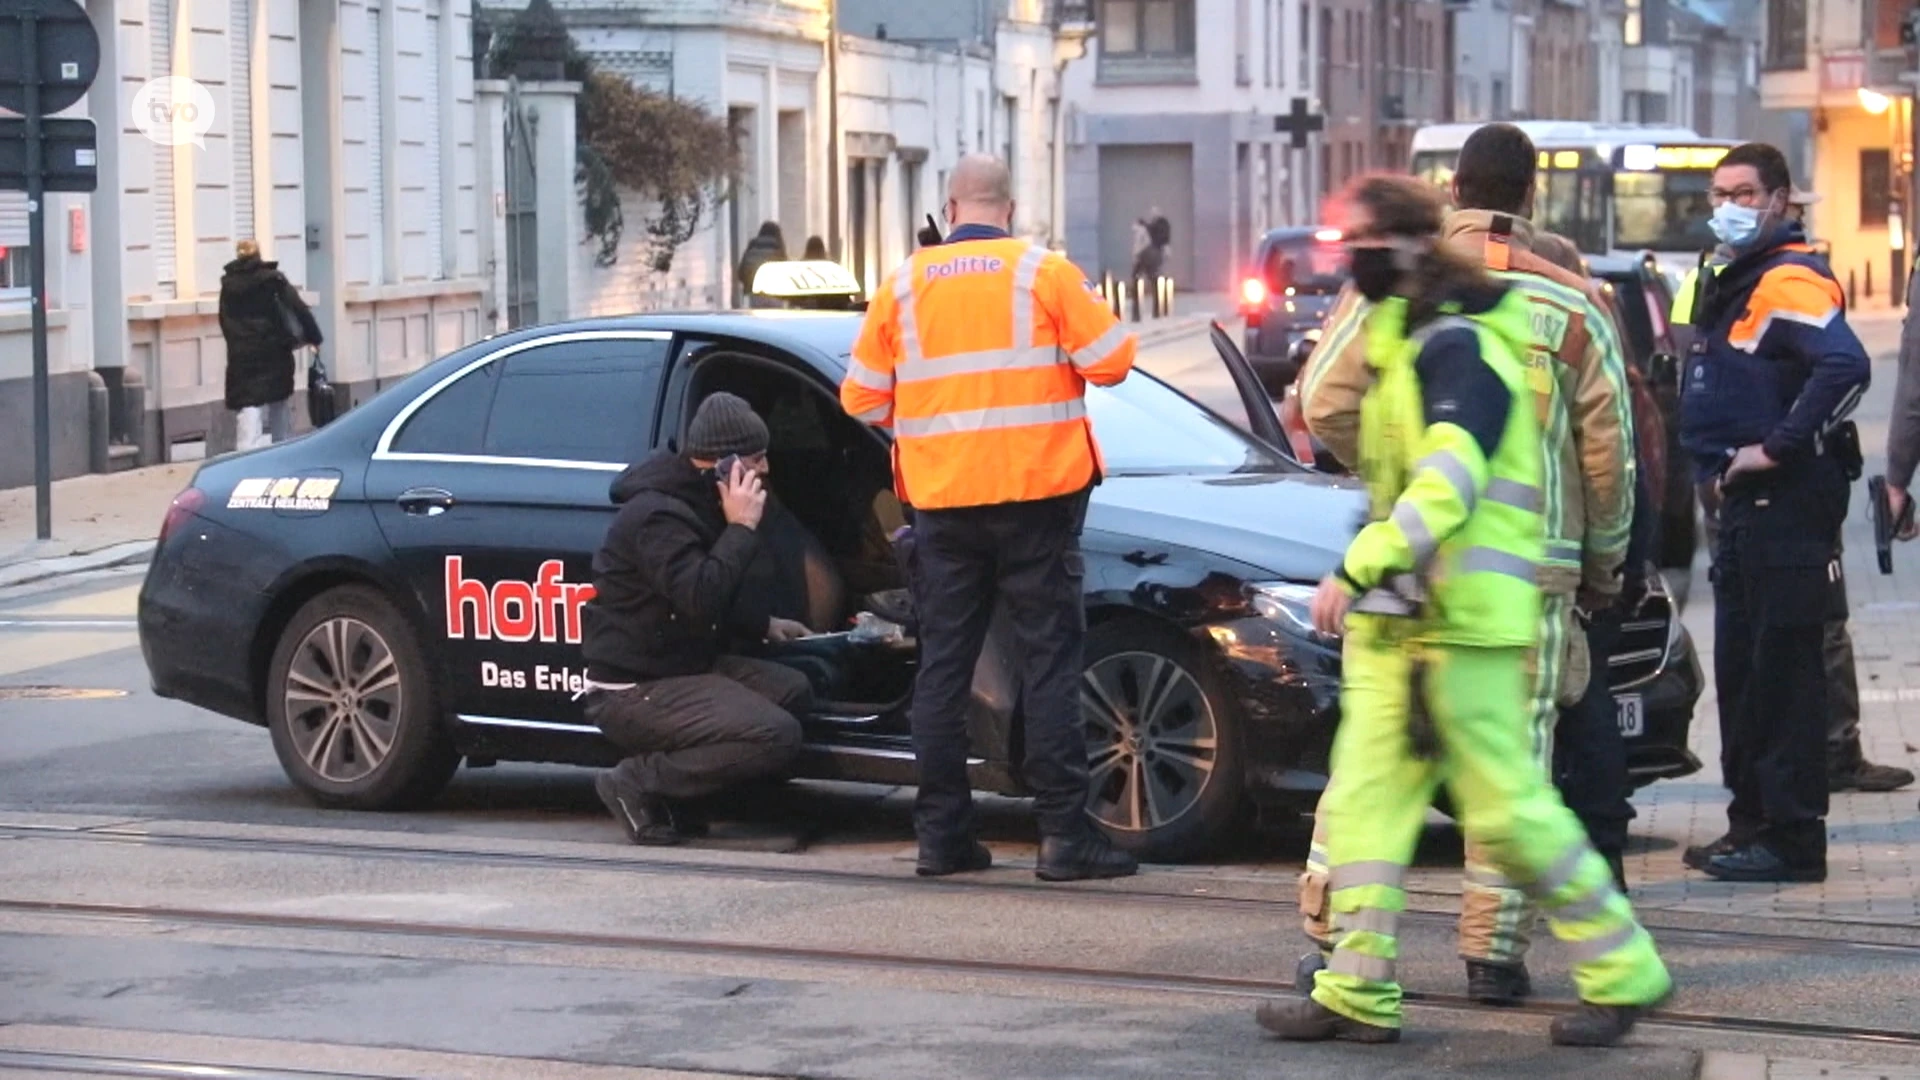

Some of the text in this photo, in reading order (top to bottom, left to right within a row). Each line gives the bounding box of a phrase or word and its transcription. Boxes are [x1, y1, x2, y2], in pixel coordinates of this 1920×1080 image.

[926, 255, 1001, 280] Politie
[445, 555, 597, 644] hofr
[481, 661, 527, 689] Das
[1616, 701, 1636, 731] 18
